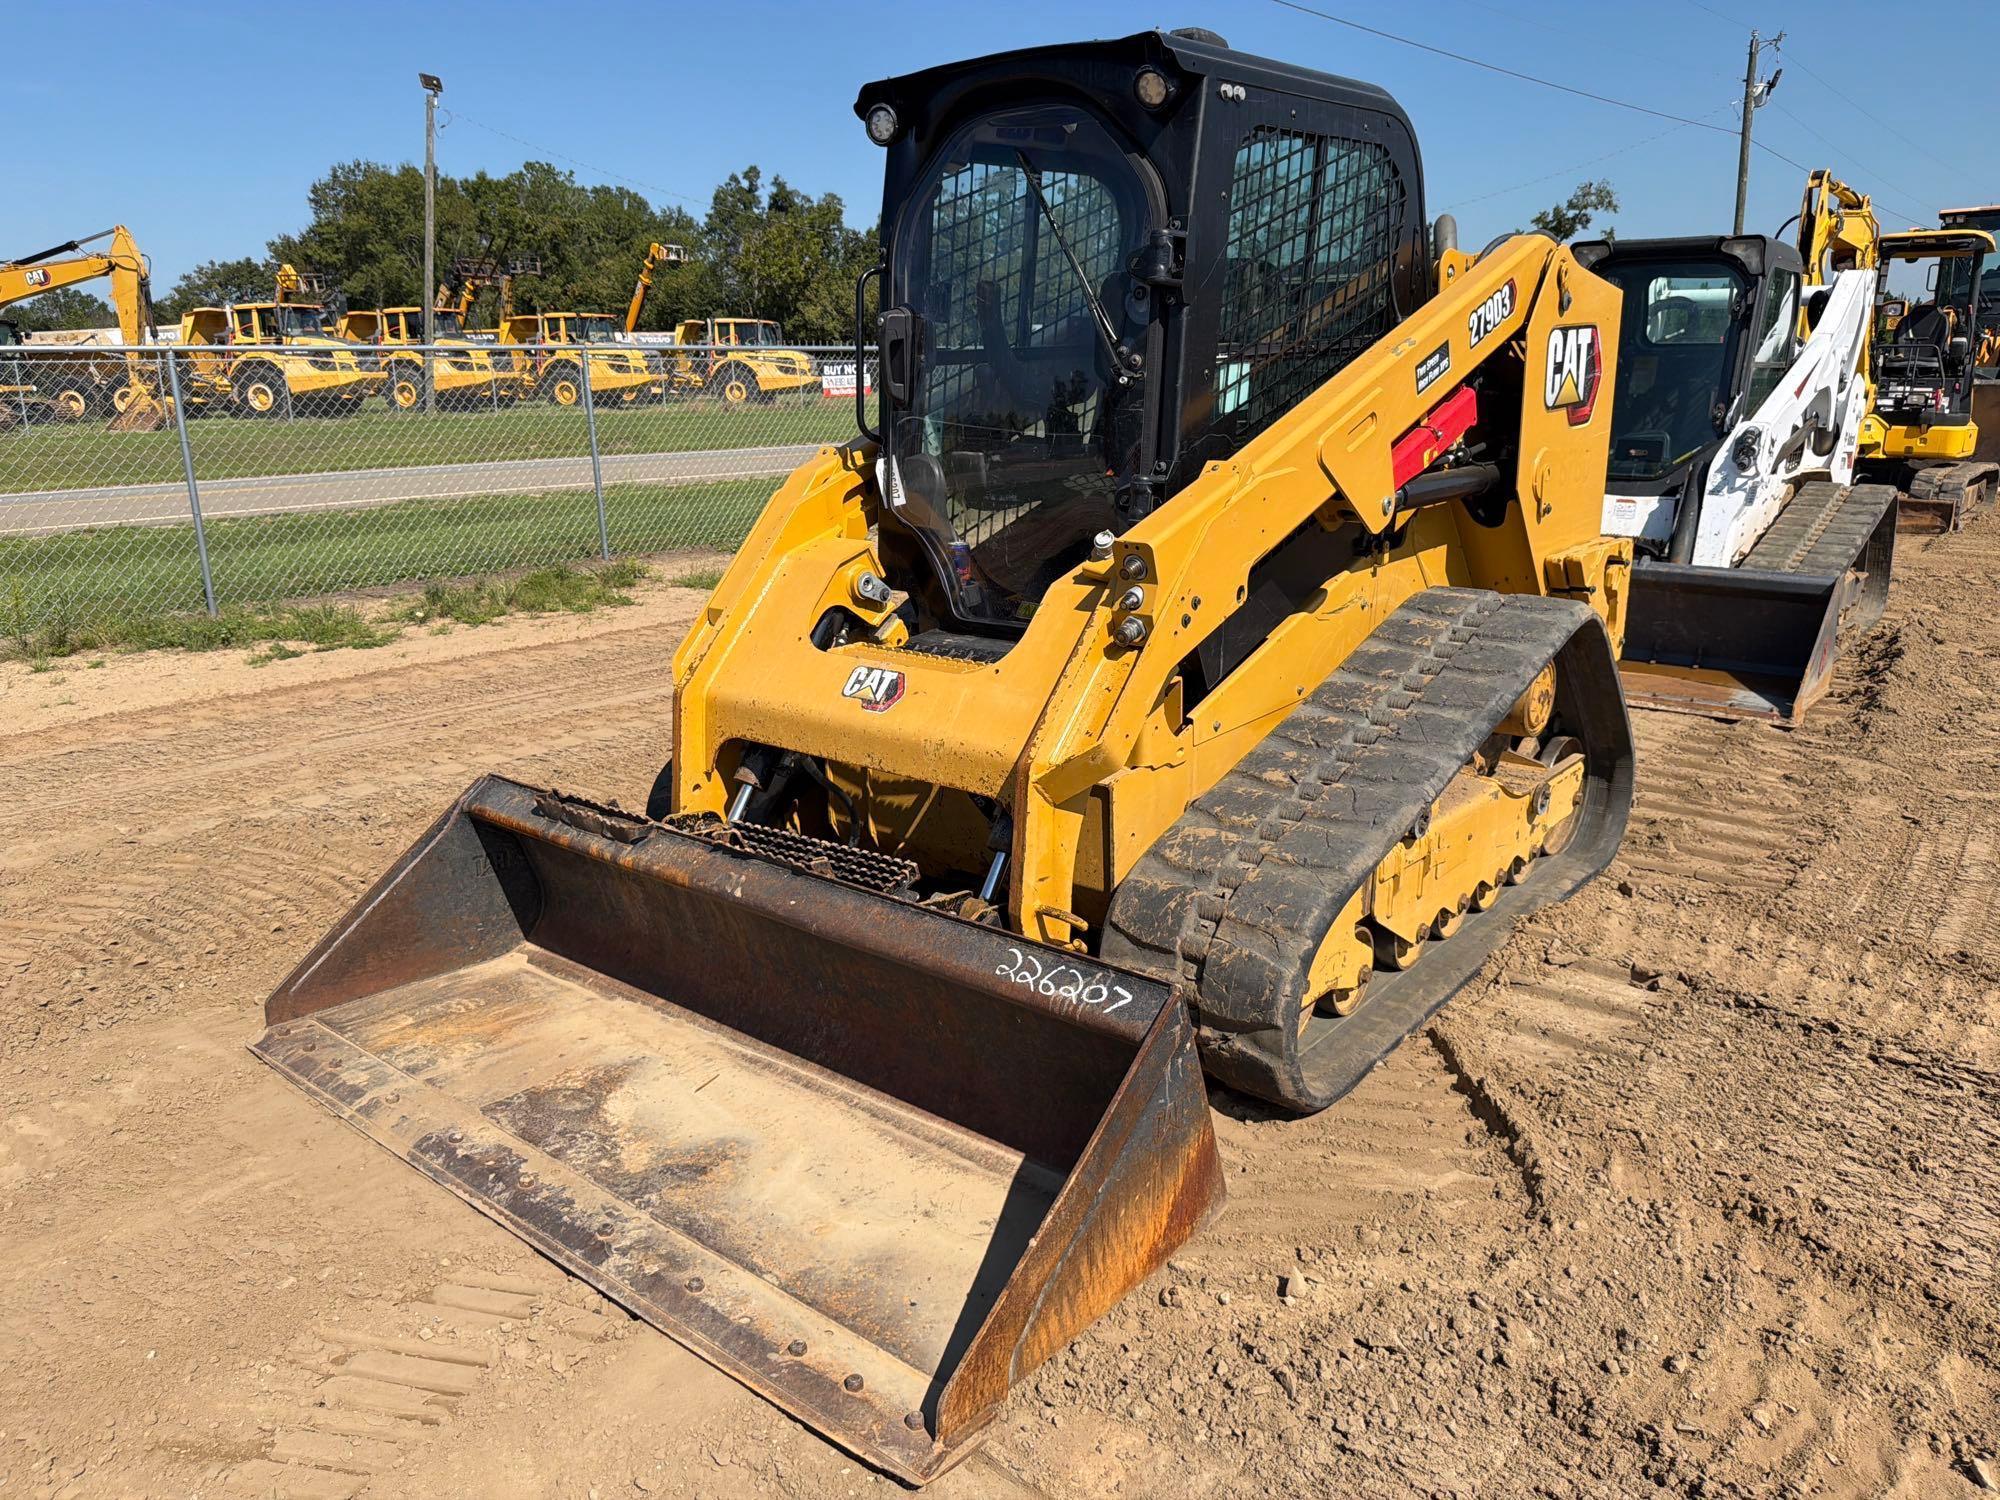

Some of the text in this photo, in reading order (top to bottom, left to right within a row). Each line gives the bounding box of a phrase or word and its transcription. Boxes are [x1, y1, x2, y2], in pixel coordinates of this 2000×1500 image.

[26, 269, 45, 285] CAT
[1470, 284, 1511, 347] 279D3
[640, 336, 671, 344] VOLVO
[823, 365, 843, 376] BUY
[1545, 327, 1592, 408] CAT
[842, 666, 899, 702] CAT
[995, 948, 1133, 1014] 226207
